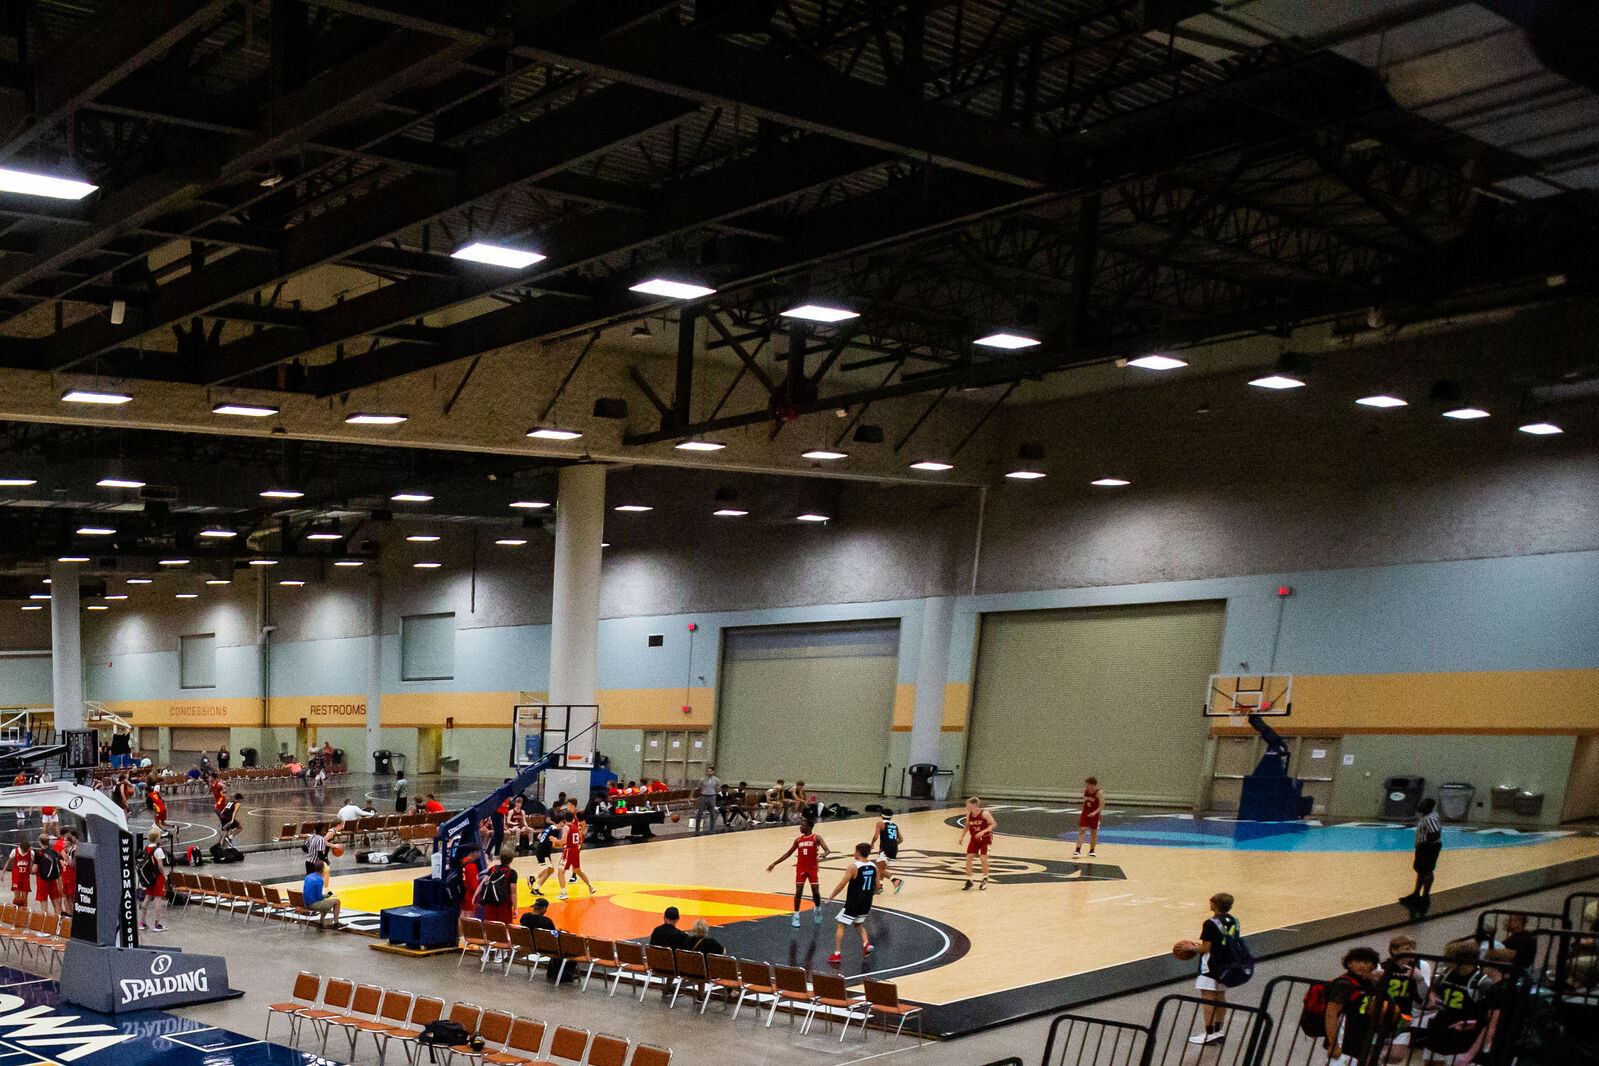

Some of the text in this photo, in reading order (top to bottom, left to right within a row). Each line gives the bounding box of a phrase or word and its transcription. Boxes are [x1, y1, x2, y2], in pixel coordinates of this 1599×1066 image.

[310, 704, 367, 716] RESTROOMS
[77, 884, 94, 895] Proud
[74, 902, 97, 915] Sponsor
[120, 967, 208, 1005] SPALDING
[1443, 988, 1465, 1009] 12
